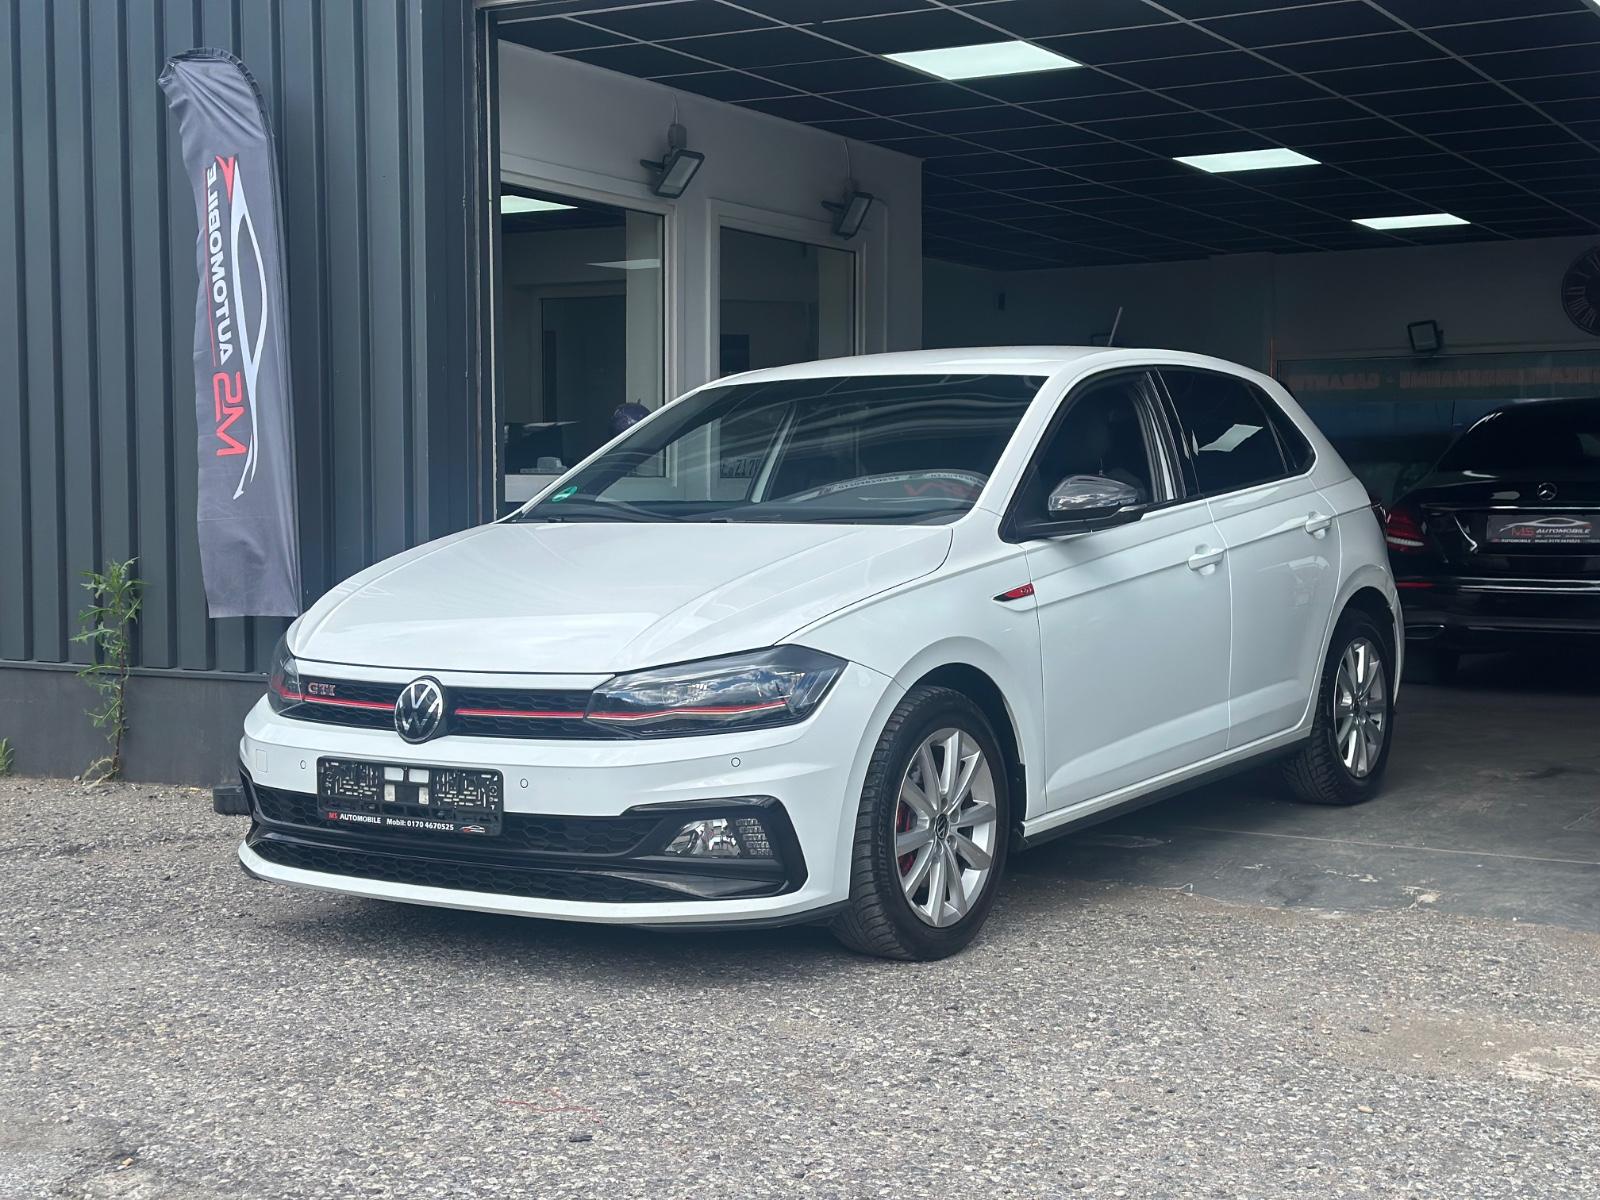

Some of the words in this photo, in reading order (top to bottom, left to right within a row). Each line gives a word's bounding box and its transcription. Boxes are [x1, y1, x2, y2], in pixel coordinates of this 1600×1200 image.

[307, 682, 336, 697] GTI
[339, 812, 382, 824] AUTOMOBILE
[406, 820, 424, 828] 0170
[425, 822, 454, 831] 4670525
